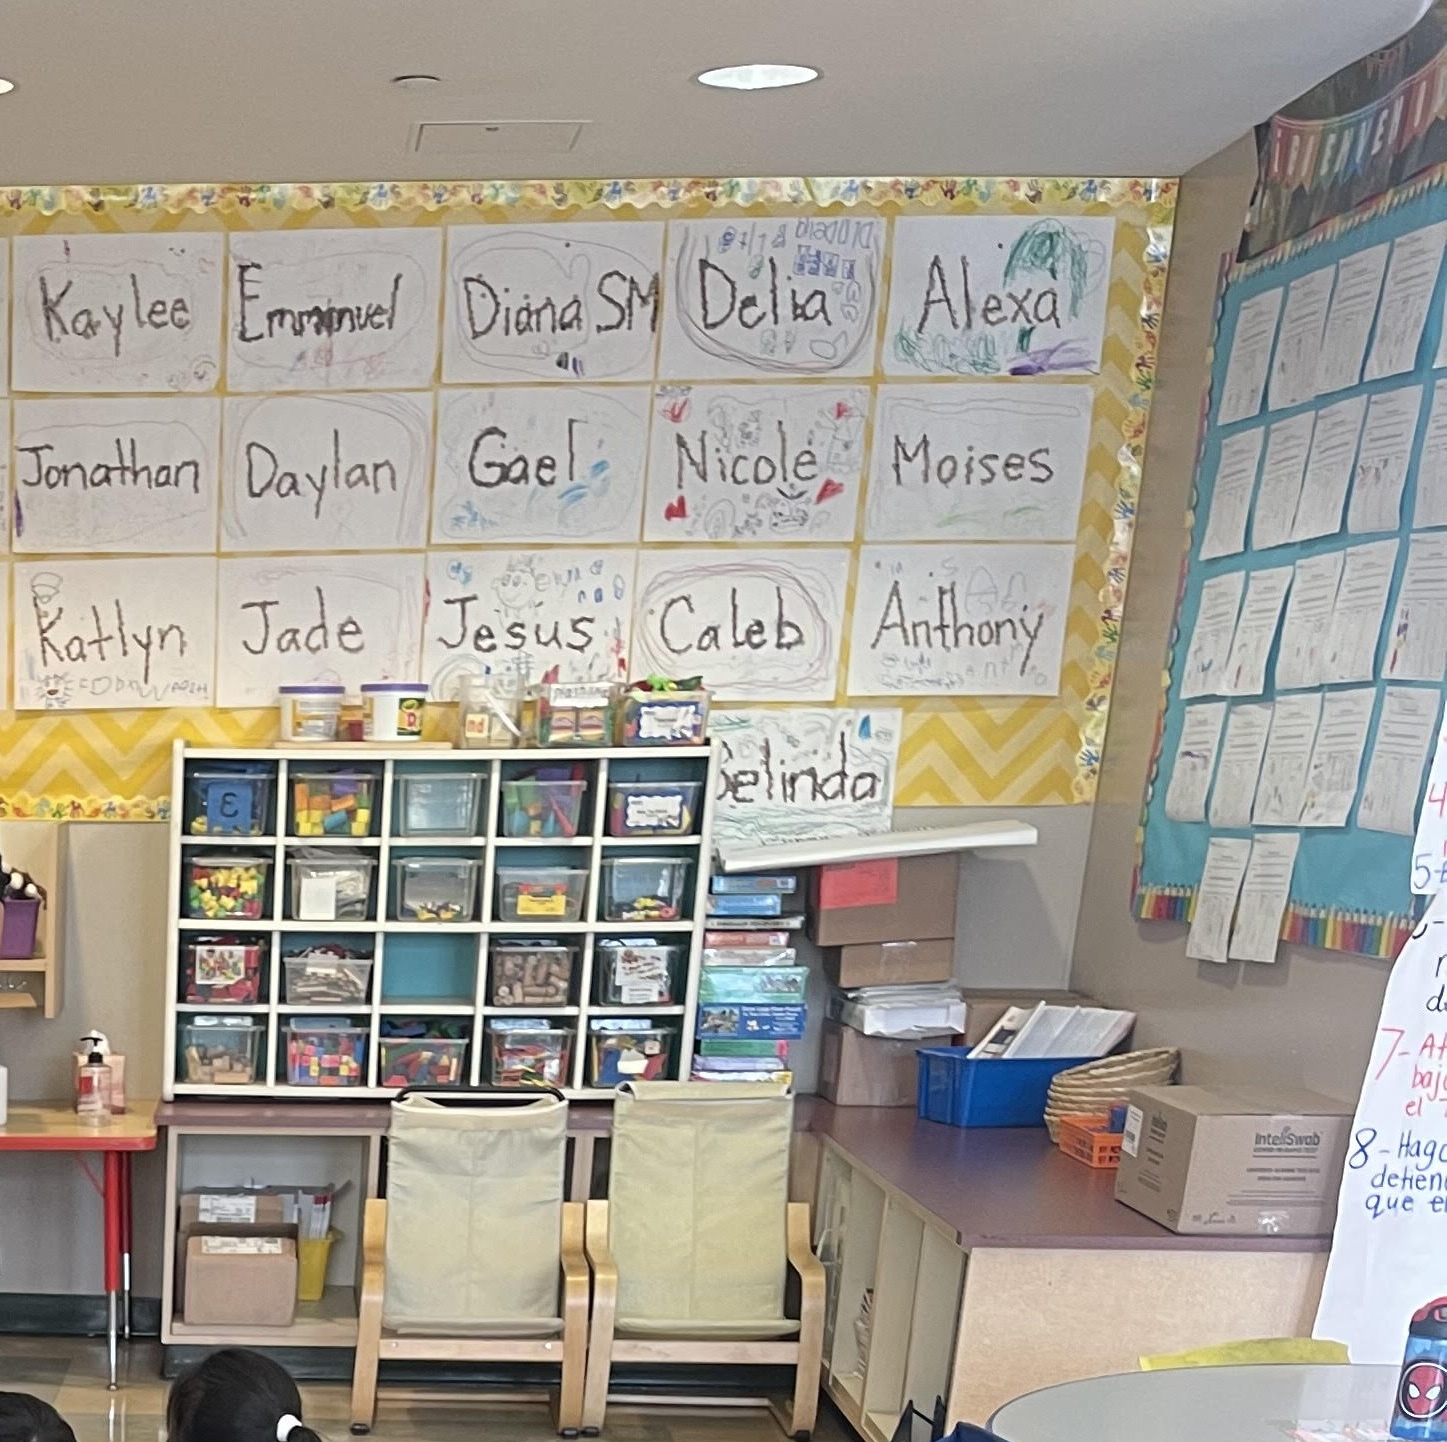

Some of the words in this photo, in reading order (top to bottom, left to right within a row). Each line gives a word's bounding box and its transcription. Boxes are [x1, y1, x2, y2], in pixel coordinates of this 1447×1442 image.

[39, 271, 192, 356] Kaylee
[463, 273, 583, 340] Diana
[596, 270, 661, 335] SM
[917, 254, 1062, 335] Alexa
[17, 438, 200, 495] Jonathan
[246, 429, 397, 519] Daylan
[468, 418, 586, 488] Gael
[676, 420, 818, 488] Nicole
[891, 434, 1054, 486] Moises
[33, 596, 188, 684] Katlyn
[242, 586, 365, 655] Jade
[436, 594, 596, 654] Jesus
[659, 587, 805, 655] Caleb
[870, 580, 1045, 676] Anthony
[1405, 1097, 1423, 1117] el
[1365, 1194, 1414, 1220] que
[1371, 1164, 1447, 1192] detien
